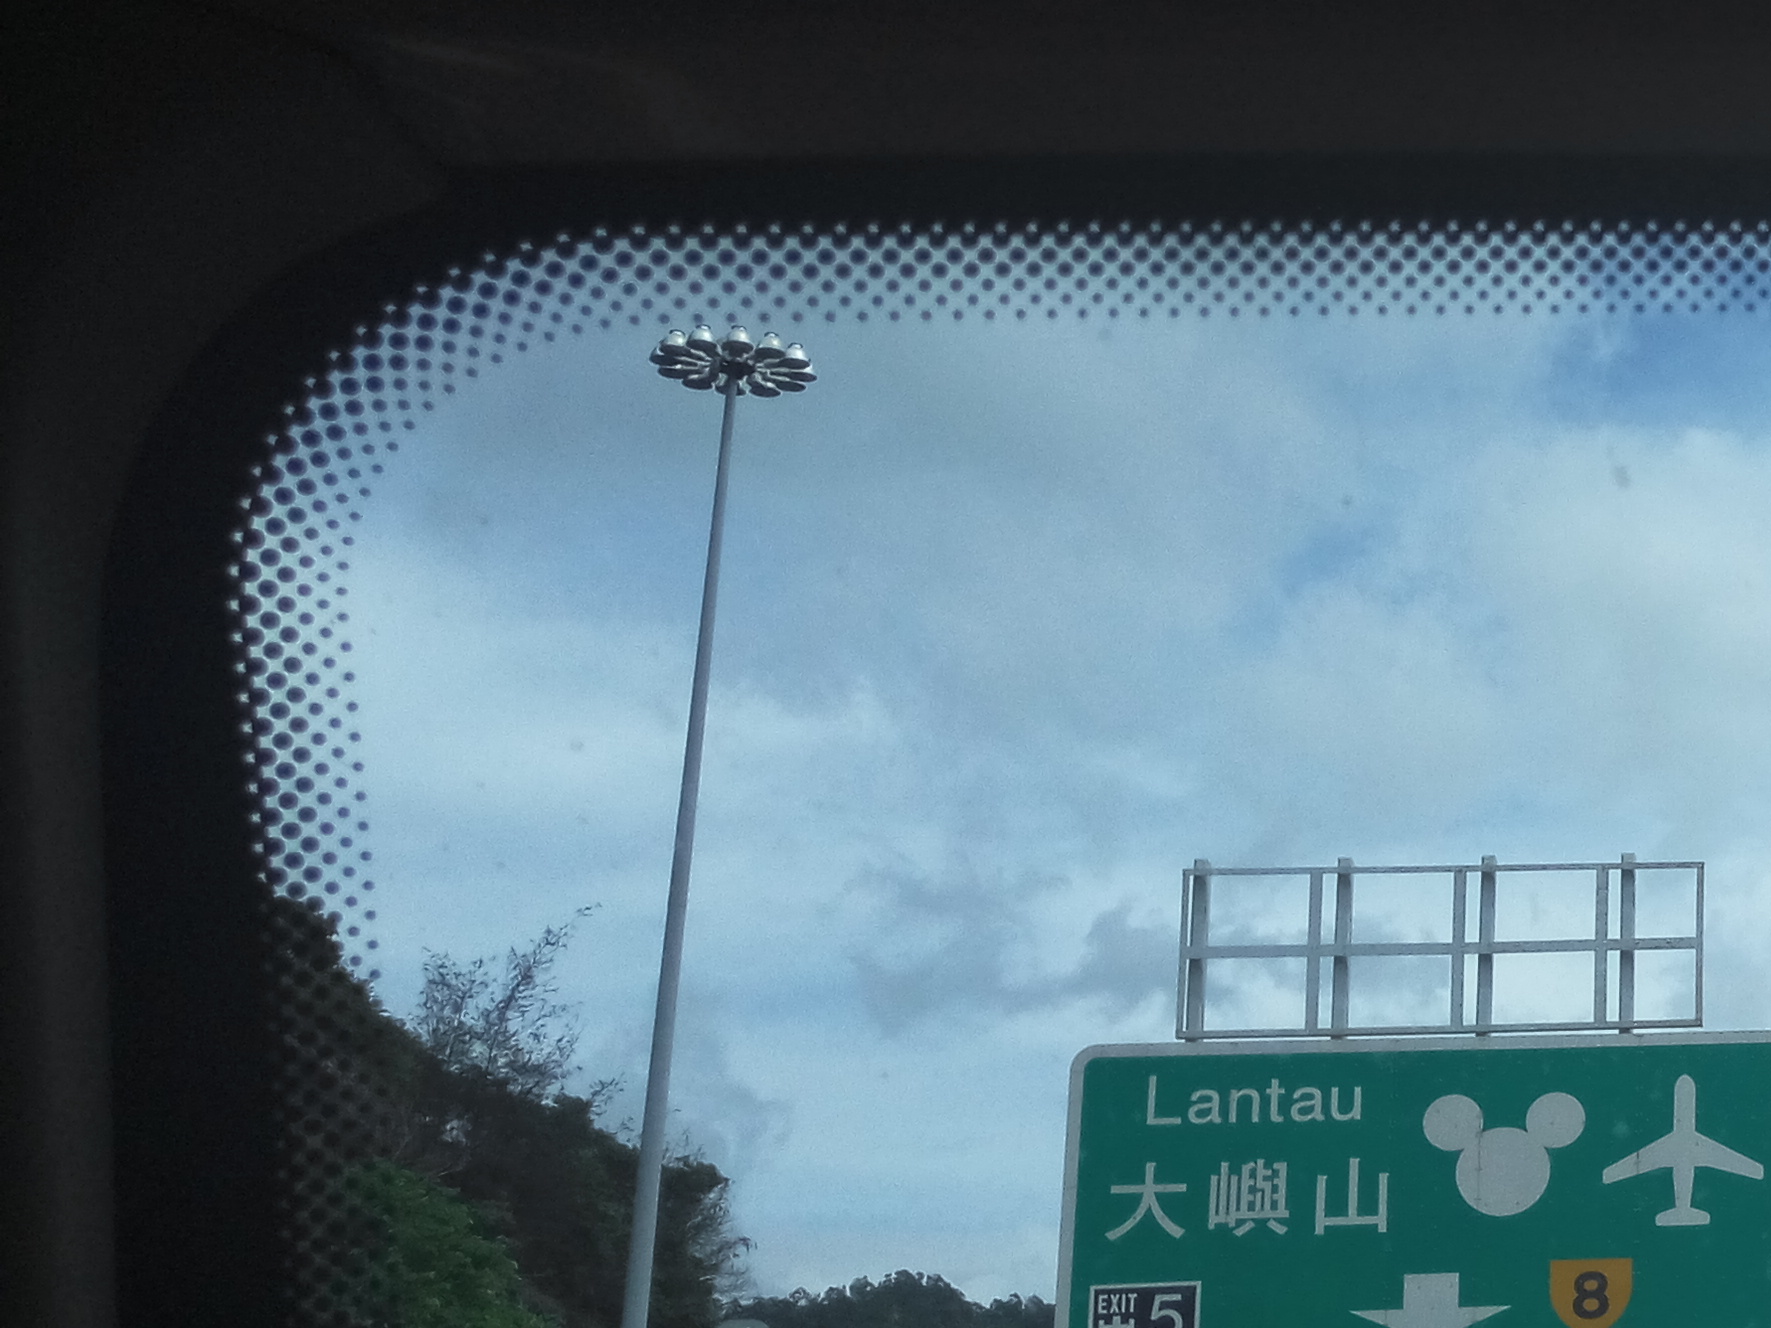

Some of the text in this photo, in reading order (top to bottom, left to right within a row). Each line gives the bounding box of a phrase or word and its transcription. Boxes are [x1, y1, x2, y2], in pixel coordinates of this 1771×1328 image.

[1146, 1073, 1363, 1126] Lantau
[1104, 1156, 1390, 1242] 大嶼山
[1097, 1293, 1138, 1314] EXIT
[1572, 1271, 1609, 1319] 8
